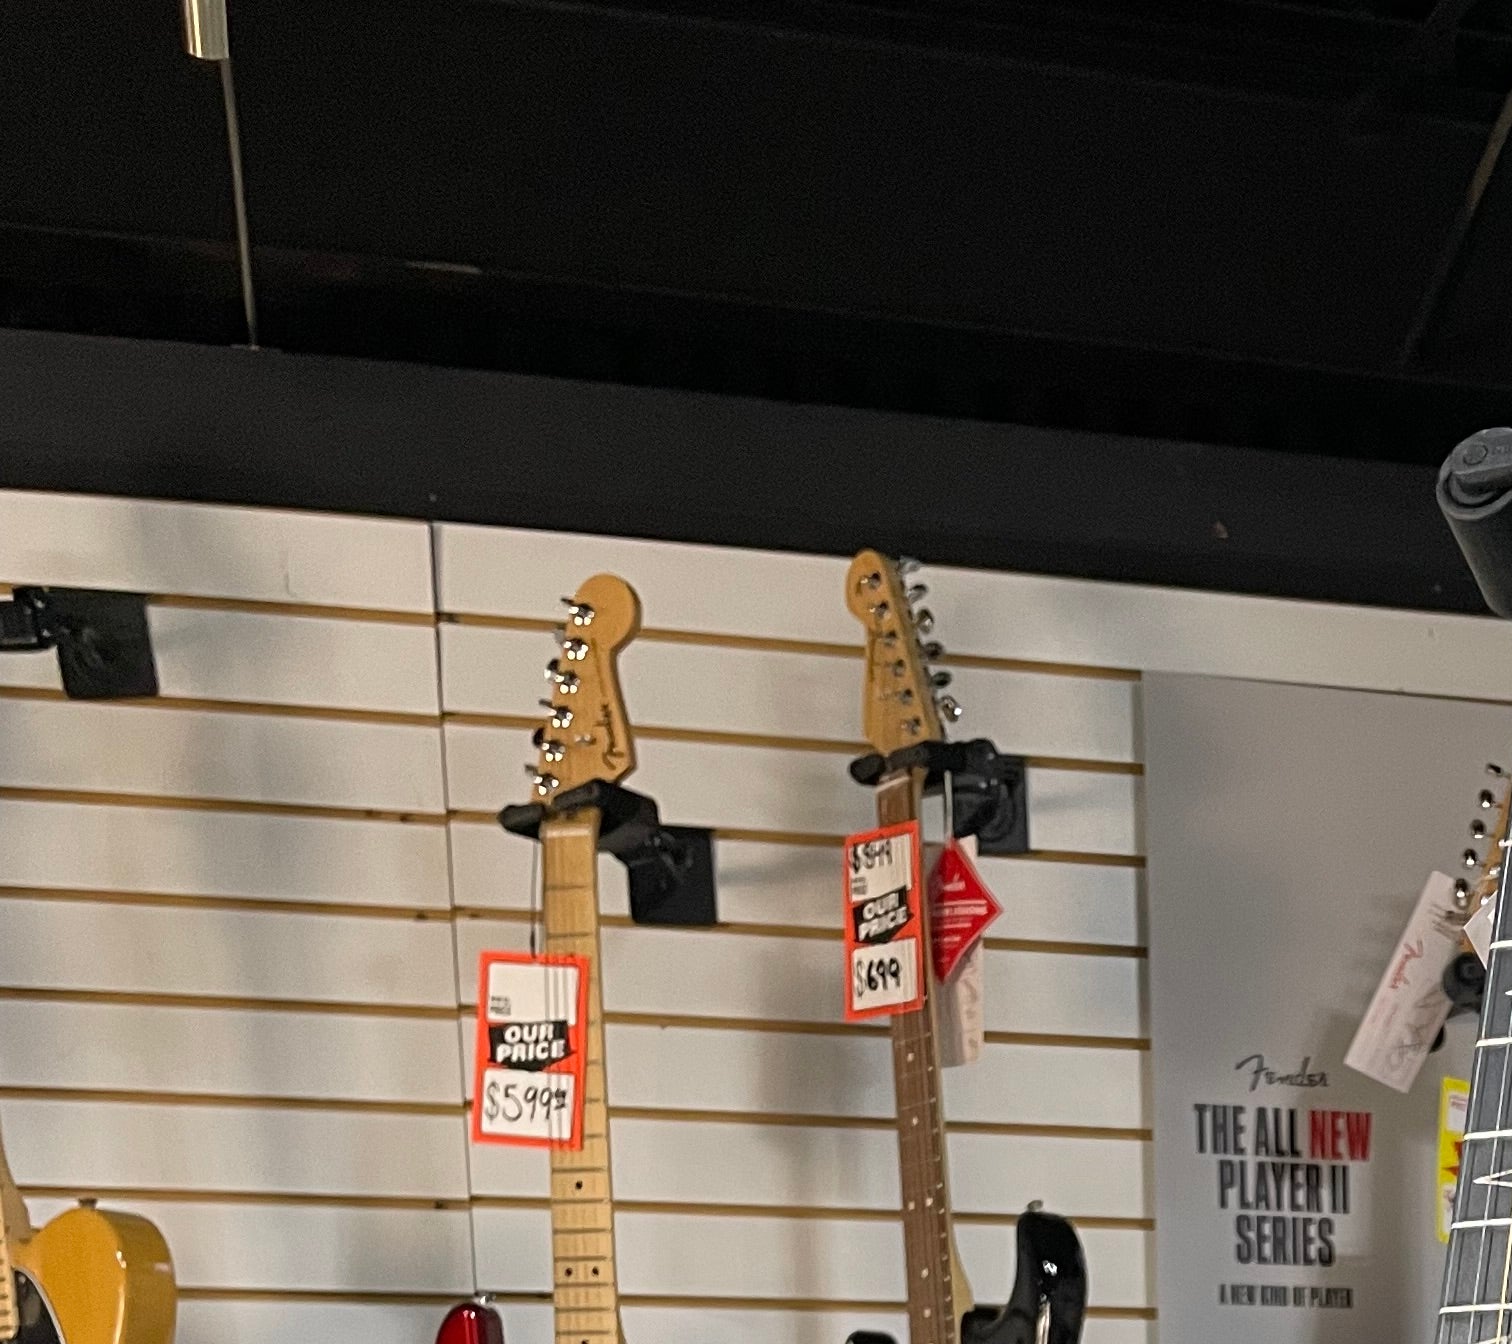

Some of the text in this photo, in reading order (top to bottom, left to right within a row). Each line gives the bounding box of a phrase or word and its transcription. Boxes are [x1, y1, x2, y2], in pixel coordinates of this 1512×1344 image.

[858, 905, 908, 942] PRICE
[862, 892, 900, 922] OUR
[856, 957, 901, 998] $699
[496, 1039, 565, 1062] PRICE
[503, 1023, 554, 1043] OUR
[1235, 1054, 1330, 1092] Fender
[1194, 1104, 1372, 1162] THE ALL NEW
[1219, 1160, 1351, 1215] PLAYER II
[1235, 1215, 1336, 1267] SERIES
